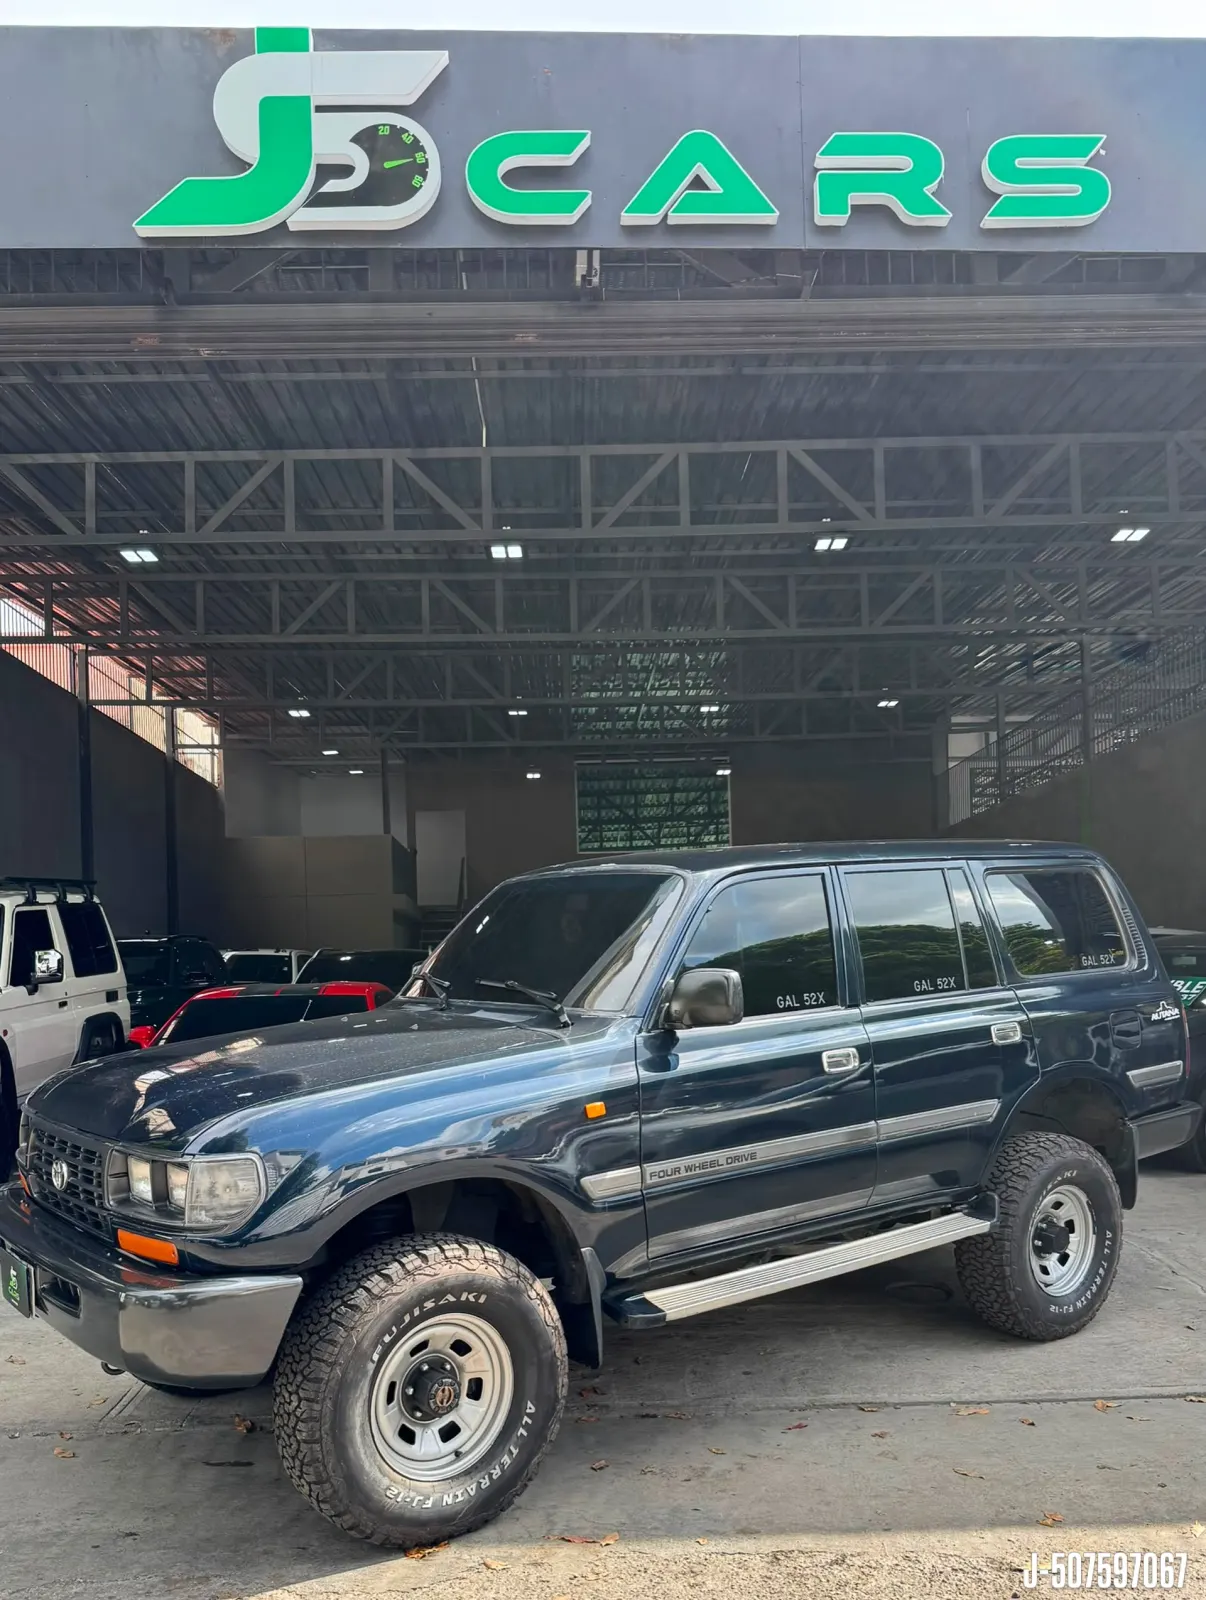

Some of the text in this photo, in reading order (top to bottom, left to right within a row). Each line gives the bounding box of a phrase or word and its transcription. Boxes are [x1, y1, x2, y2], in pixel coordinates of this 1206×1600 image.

[378, 125, 426, 189] 20 40 60 80
[465, 129, 1112, 229] CARS
[1082, 954, 1116, 966] GAL 52X
[776, 991, 826, 1009] GAL 52X
[914, 976, 957, 992] GAL 52X
[1171, 979, 1206, 994] BLE
[649, 1151, 758, 1181] FOUR WHEEL DRIVE
[1104, 1230, 1113, 1255] ALL
[1076, 1261, 1109, 1310] TERRAIN
[369, 1290, 488, 1366] FUJISAKI
[517, 1400, 537, 1437] ALL
[442, 1443, 520, 1509] TERRAIN
